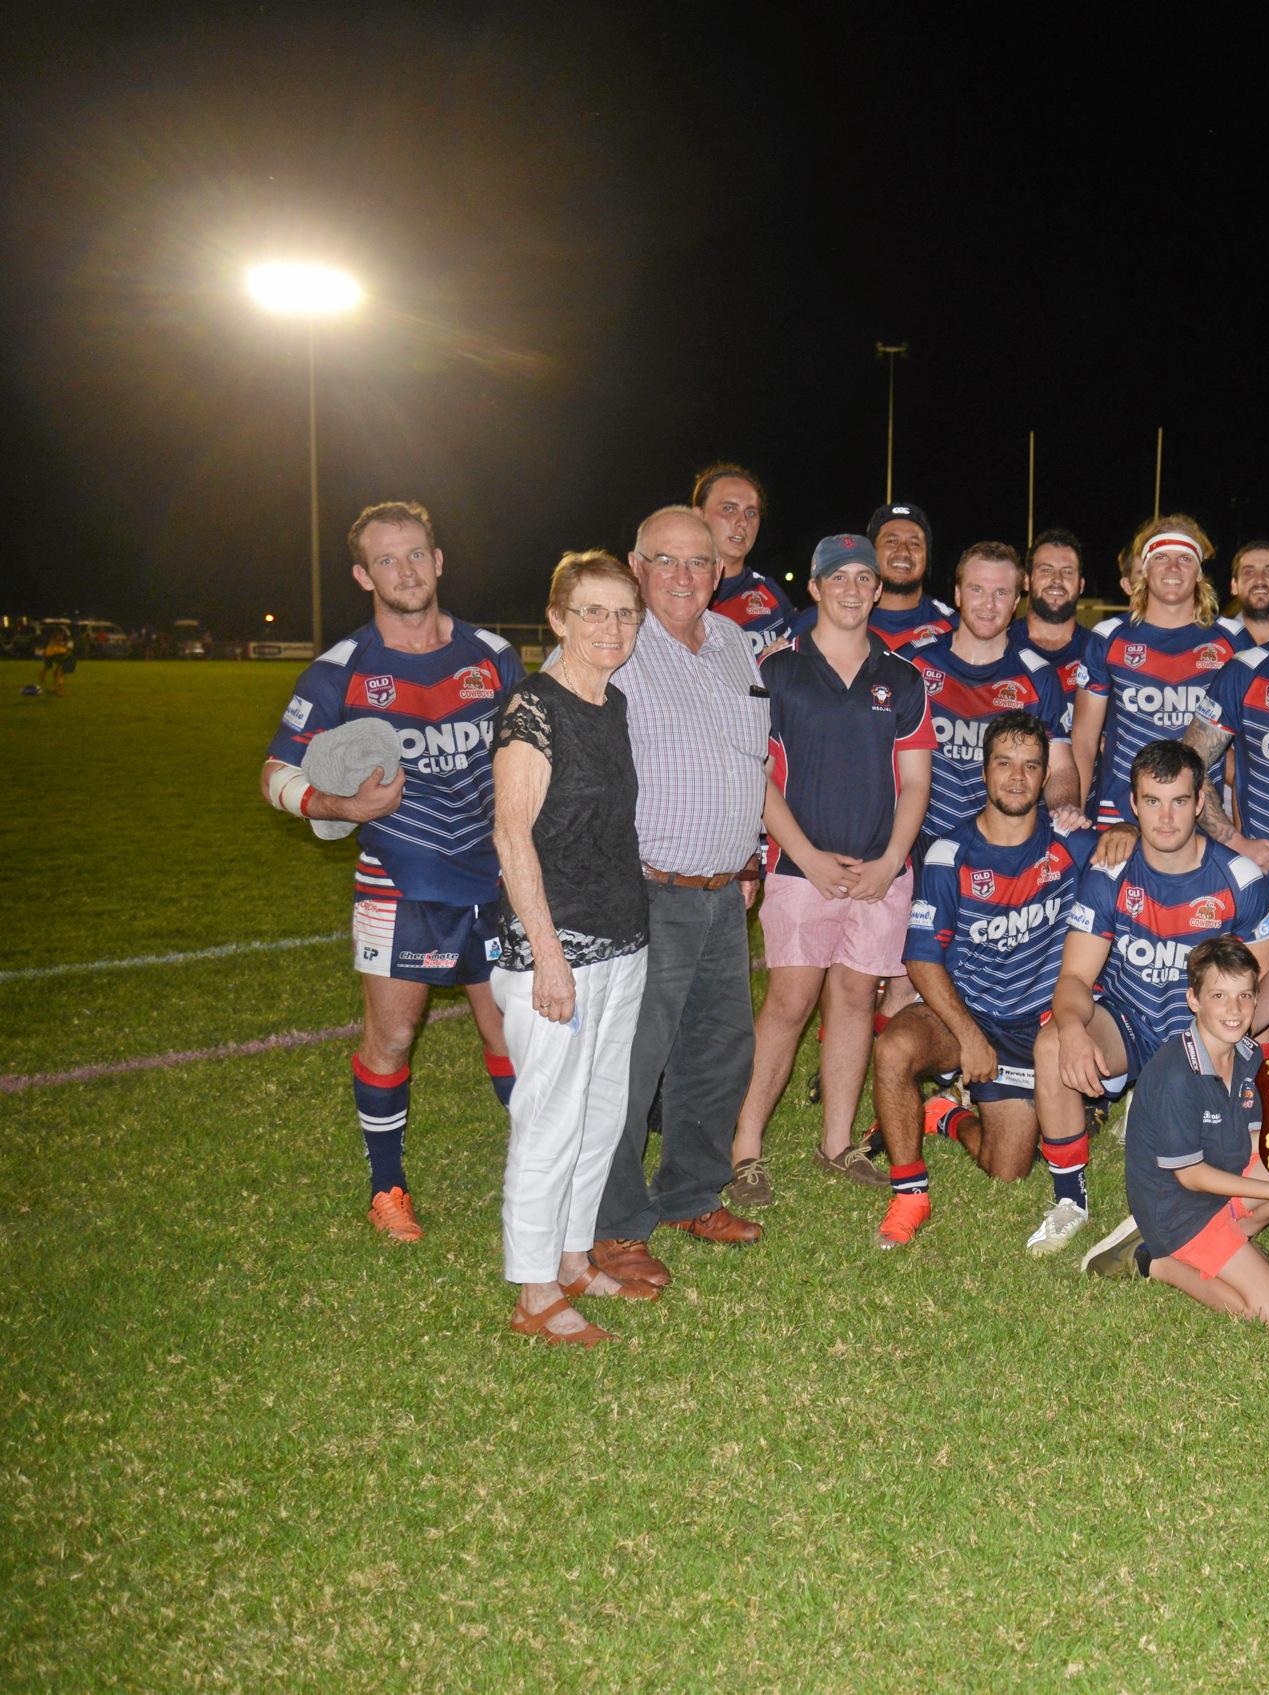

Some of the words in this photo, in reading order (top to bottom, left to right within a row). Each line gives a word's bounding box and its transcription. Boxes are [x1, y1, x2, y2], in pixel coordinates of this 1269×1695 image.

[1127, 645, 1144, 653] QLD
[925, 670, 942, 679] QLD
[369, 677, 389, 689] QLD
[460, 689, 495, 699] COWBOYS
[1122, 686, 1206, 713] COND
[1153, 712, 1194, 726] CLUB
[399, 721, 494, 759] ONDY
[943, 744, 984, 761] CLUB
[418, 753, 469, 774] CLUB
[973, 871, 990, 880] QLD
[969, 897, 1062, 944] CONDY
[1190, 918, 1222, 929] COWBOYS
[1141, 967, 1180, 985] CLUB
